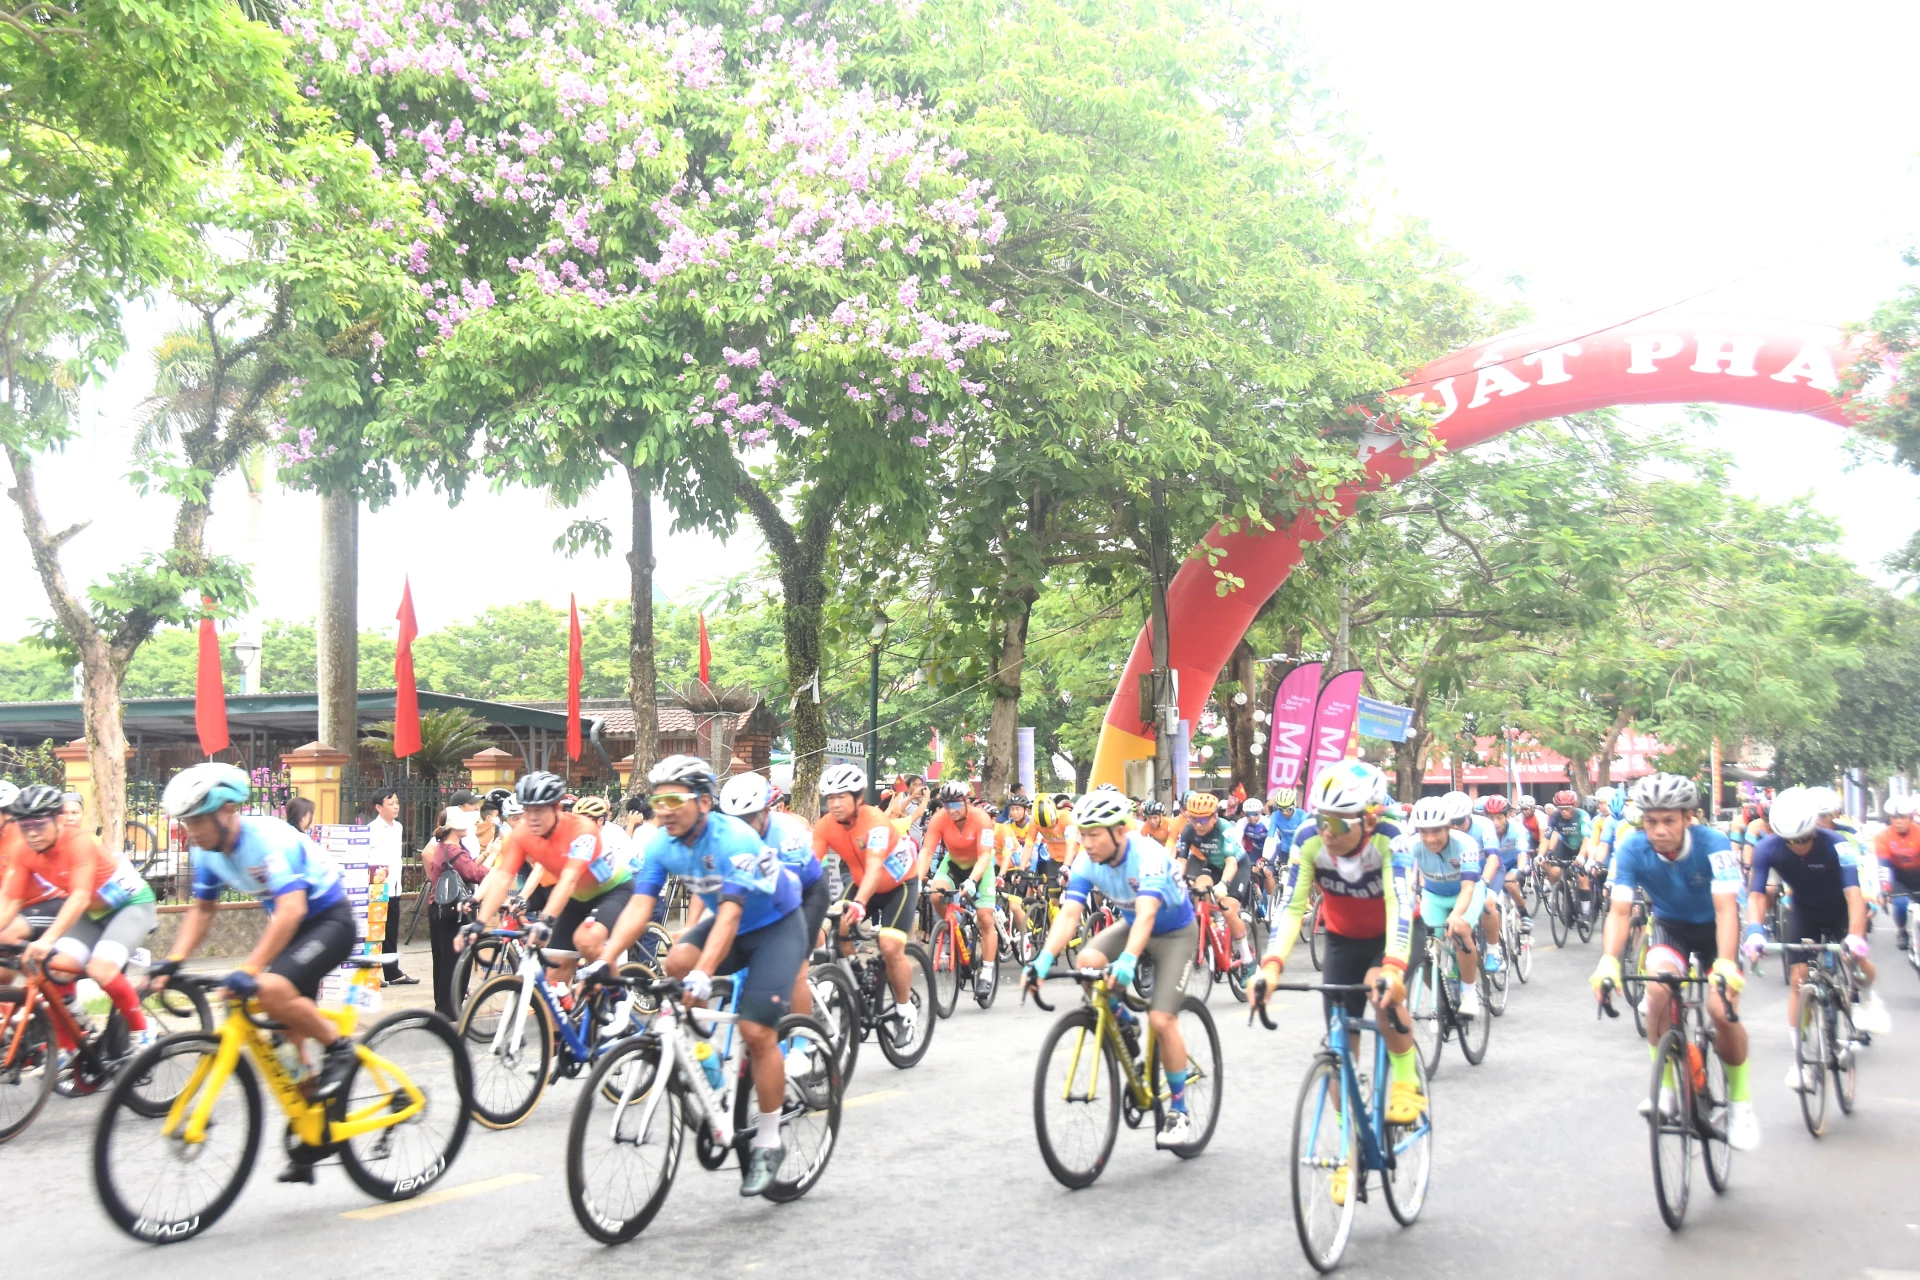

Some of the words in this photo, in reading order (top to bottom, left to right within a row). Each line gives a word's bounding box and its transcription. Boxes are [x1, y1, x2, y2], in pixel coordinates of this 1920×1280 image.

[1286, 699, 1303, 708] Being
[1291, 694, 1311, 705] Moving
[1281, 703, 1297, 711] Open
[1327, 705, 1344, 713] Being
[1332, 701, 1351, 710] Moving
[1323, 708, 1338, 716] Open
[852, 741, 864, 755] TEA
